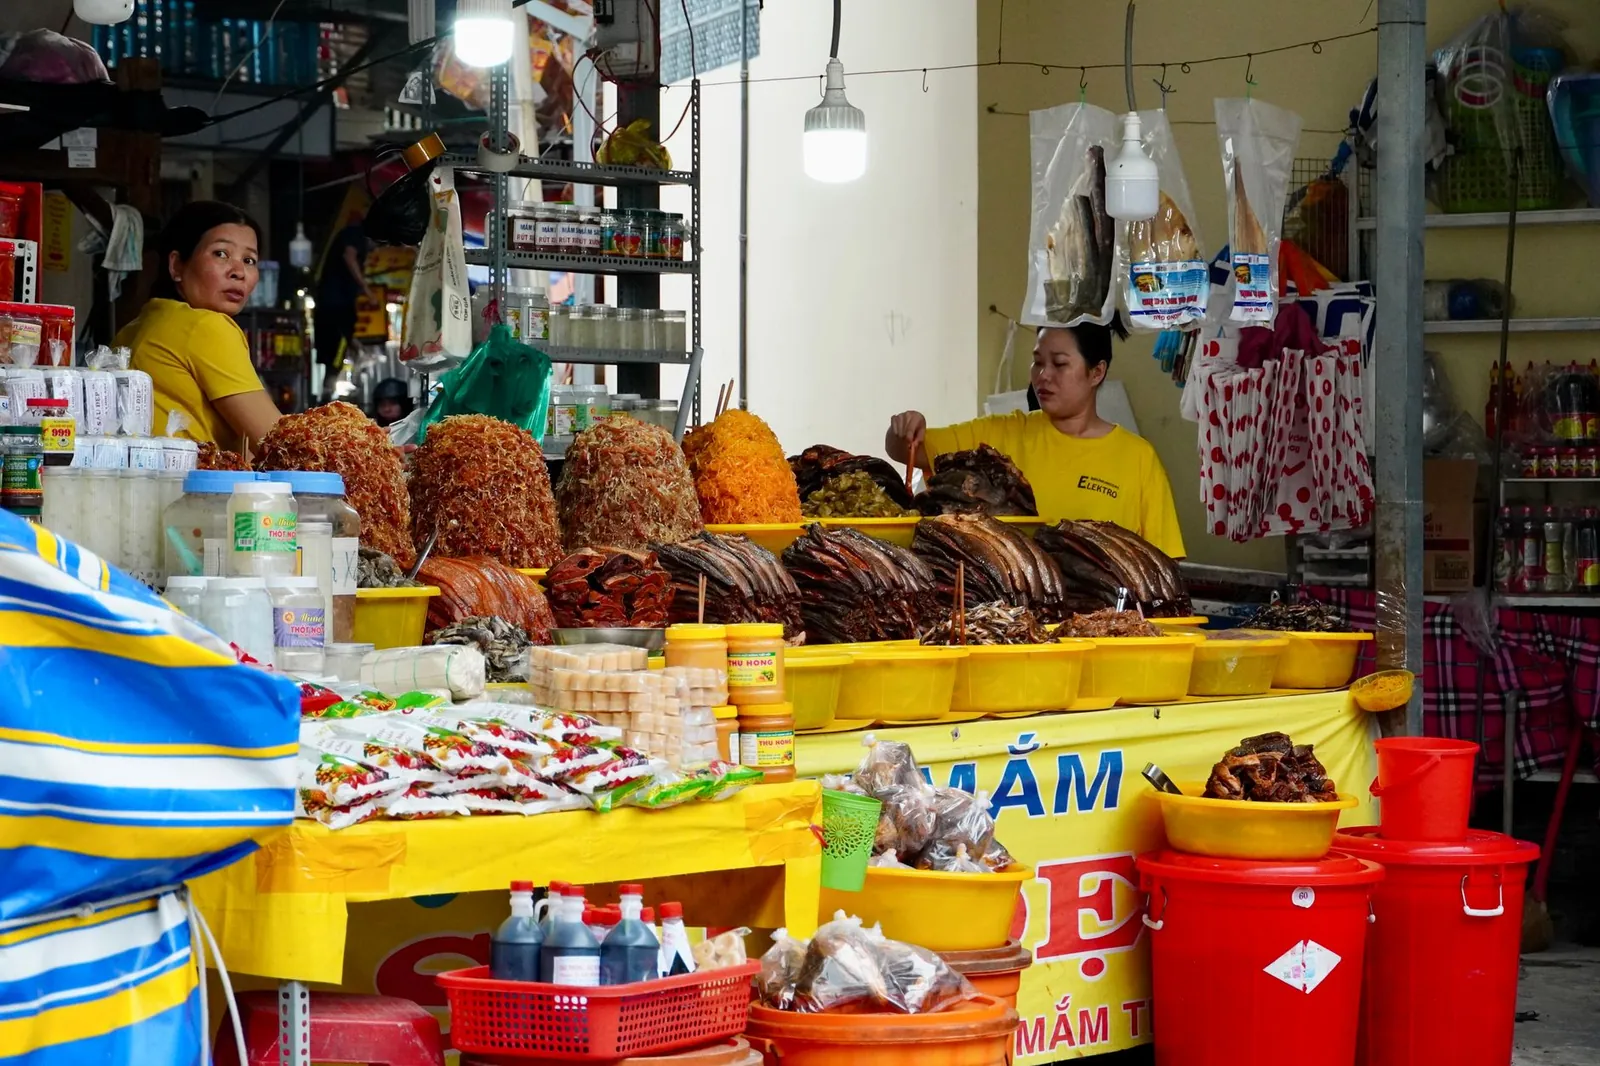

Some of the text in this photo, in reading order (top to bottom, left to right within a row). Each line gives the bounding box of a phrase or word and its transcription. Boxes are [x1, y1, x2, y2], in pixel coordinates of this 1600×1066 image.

[51, 428, 71, 437] 999
[1077, 475, 1118, 499] ELEKTRO
[1298, 891, 1309, 900] 60
[1016, 995, 1109, 1057] MẮM
